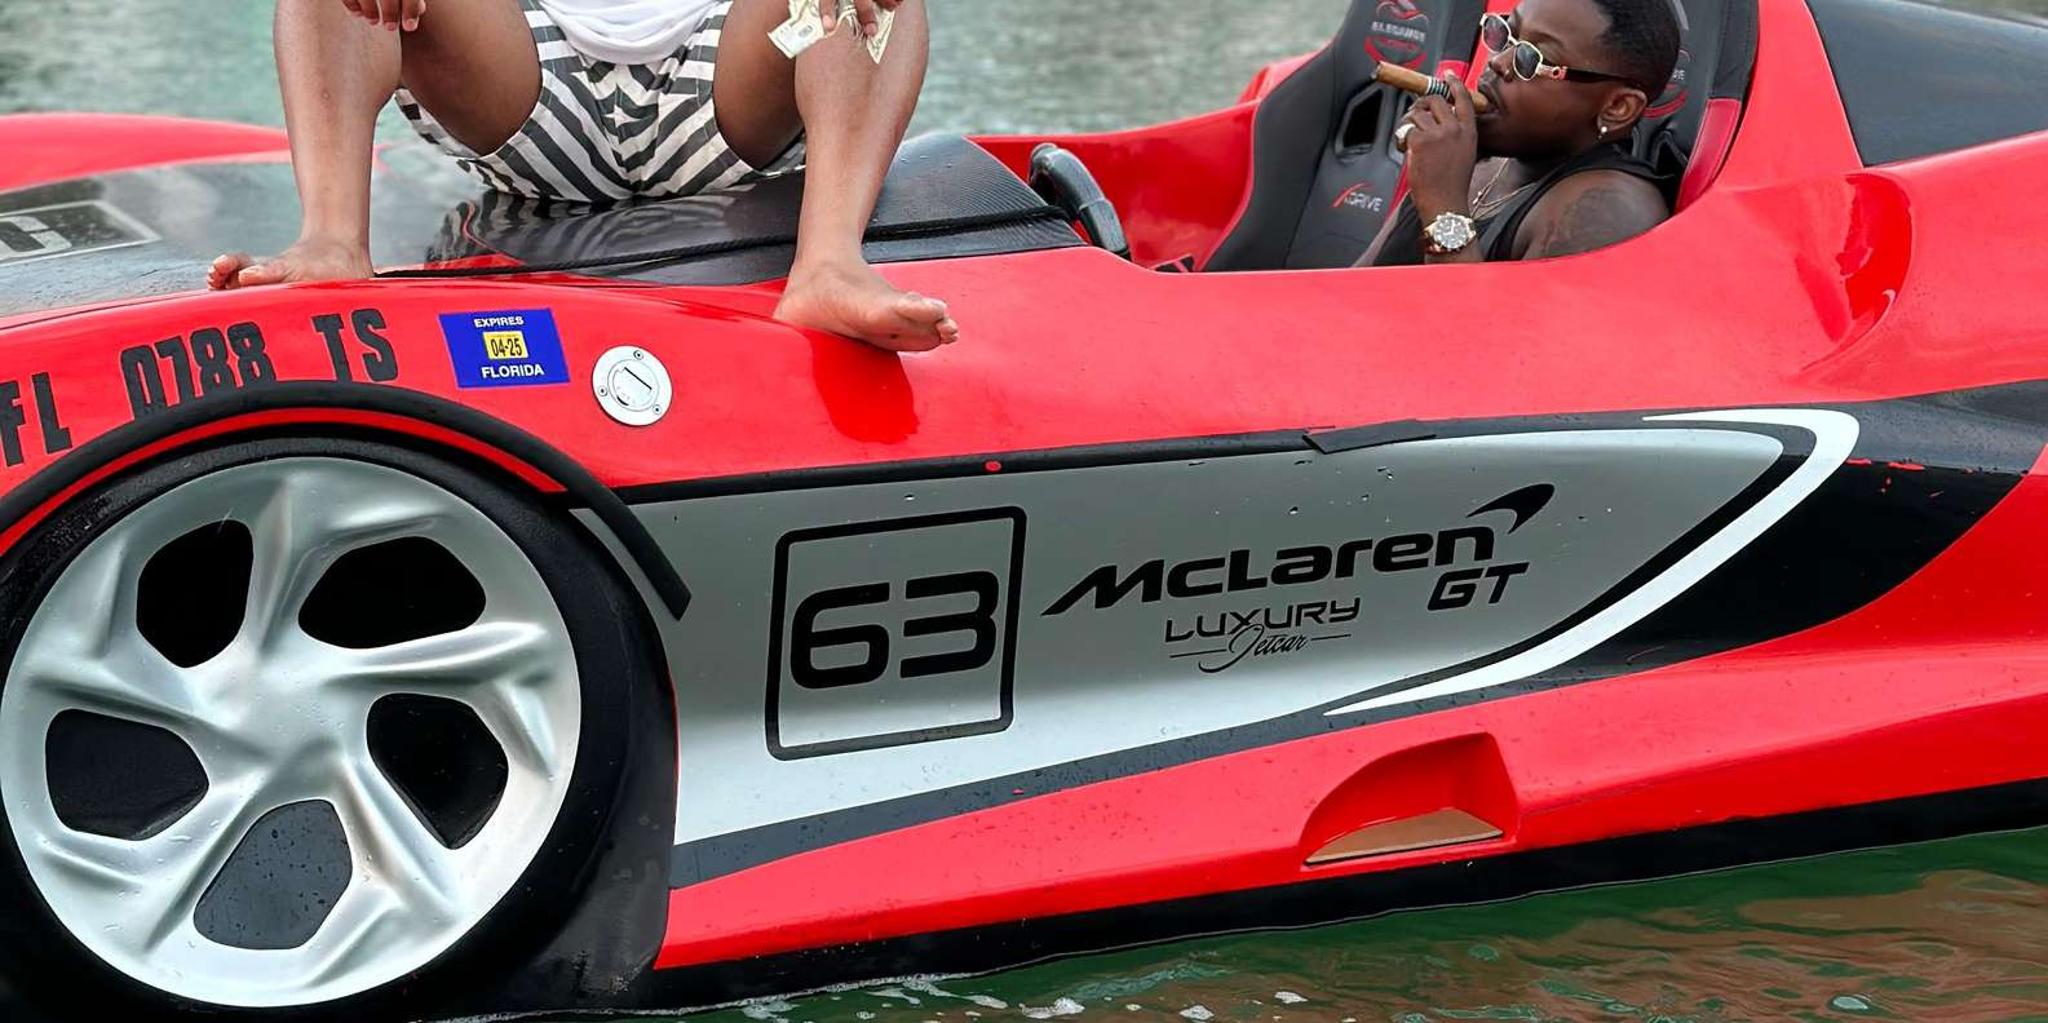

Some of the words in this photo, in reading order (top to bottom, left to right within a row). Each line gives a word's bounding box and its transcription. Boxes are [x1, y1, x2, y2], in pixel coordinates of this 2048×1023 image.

[473, 315, 525, 329] EXPIRES
[490, 337, 523, 358] 04-25
[0, 372, 72, 467] FL
[120, 322, 277, 421] 0788
[311, 308, 399, 383] TS
[481, 363, 545, 379] FLORIDA
[1040, 525, 1495, 617] McLaren
[1426, 561, 1531, 612] GT
[789, 569, 1000, 690] 63
[1163, 596, 1361, 643] LUXURY
[1198, 623, 1308, 674] Jetcar
